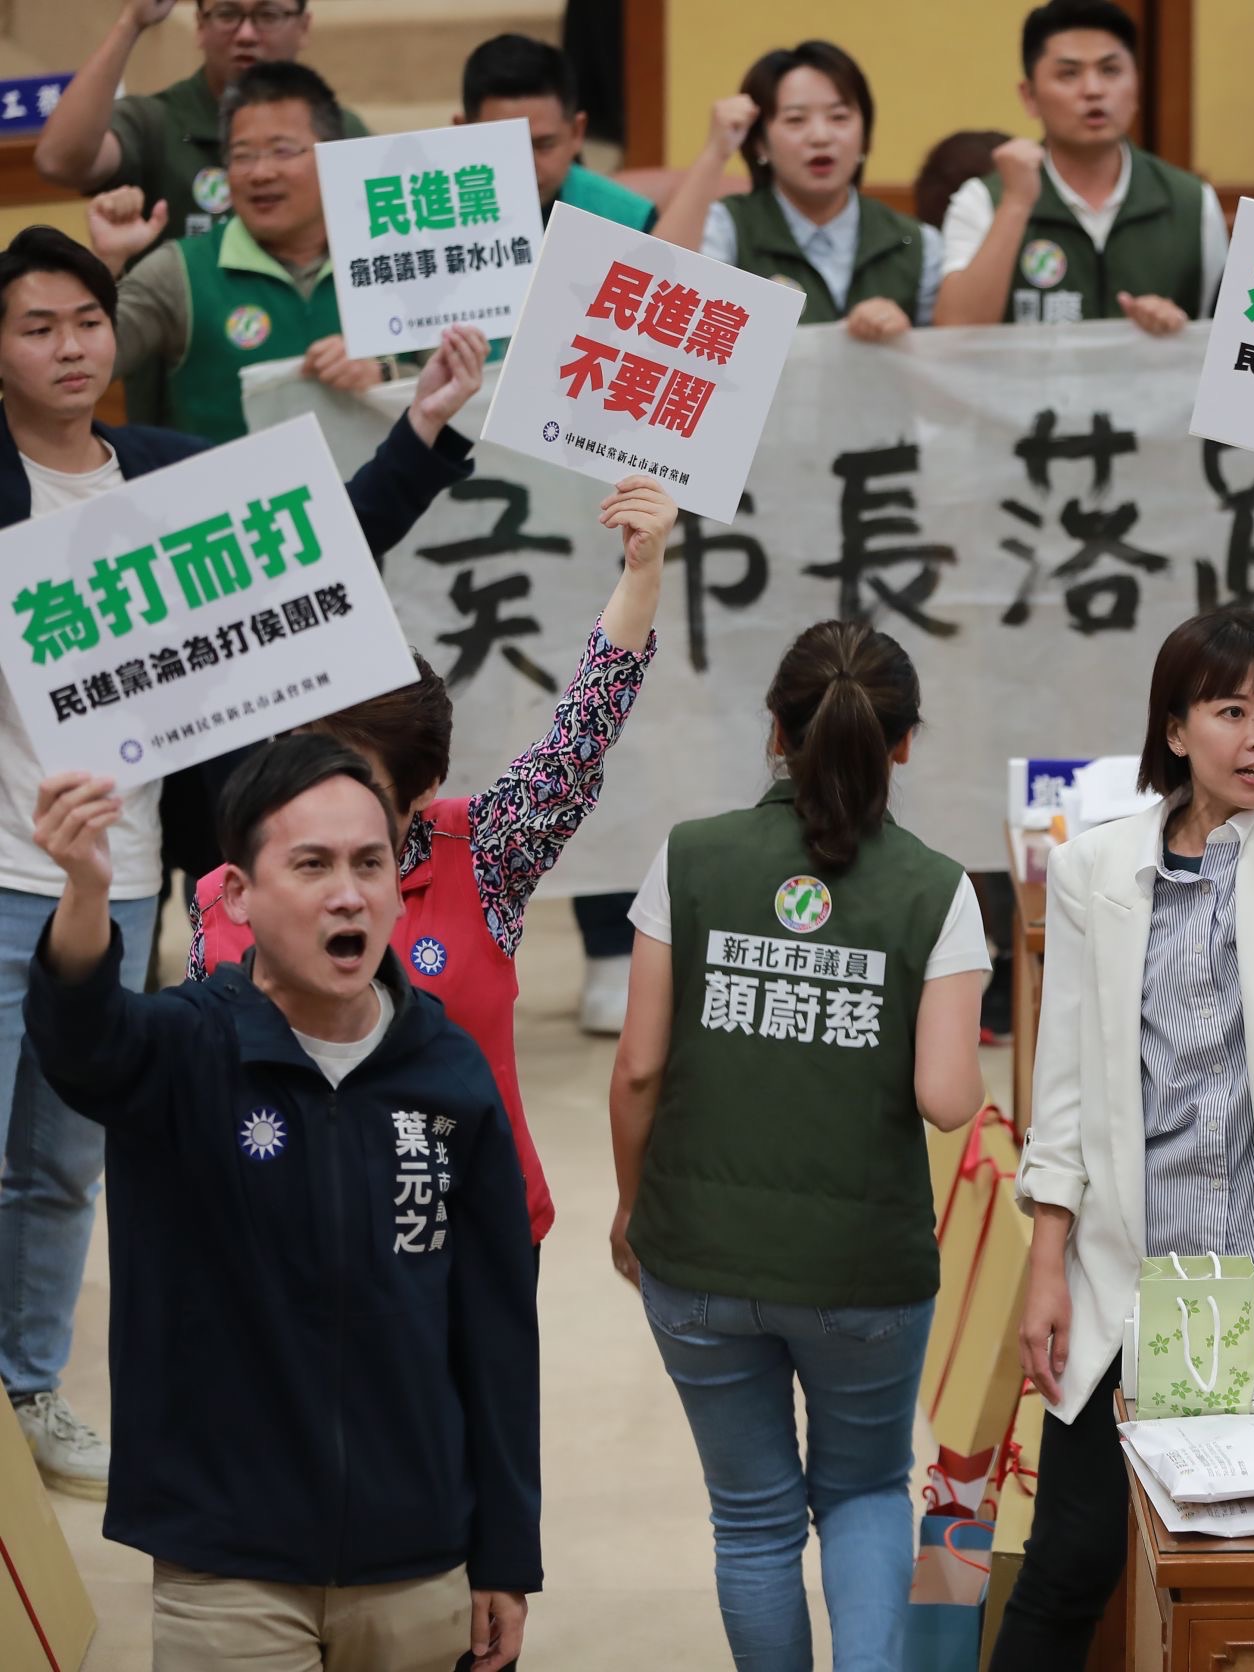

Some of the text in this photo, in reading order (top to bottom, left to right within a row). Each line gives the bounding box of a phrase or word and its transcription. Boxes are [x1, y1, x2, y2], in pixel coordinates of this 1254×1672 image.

[363, 163, 500, 240] 民進黨
[350, 236, 532, 288] 癱瘓議事 薪水小偷
[585, 260, 750, 365] 民進黨
[559, 334, 717, 438] 不要鬧
[565, 432, 690, 486] 中國國民黨新北市議會黨團
[12, 485, 322, 666] 為打而打
[48, 583, 353, 724] 民進黨淪為打侯團隊
[150, 672, 331, 749] 中國國民黨新北市議會黨團
[722, 936, 869, 980] 新北市議員
[701, 970, 884, 1048] 顏蔚慈
[391, 1110, 433, 1255] 葉元之
